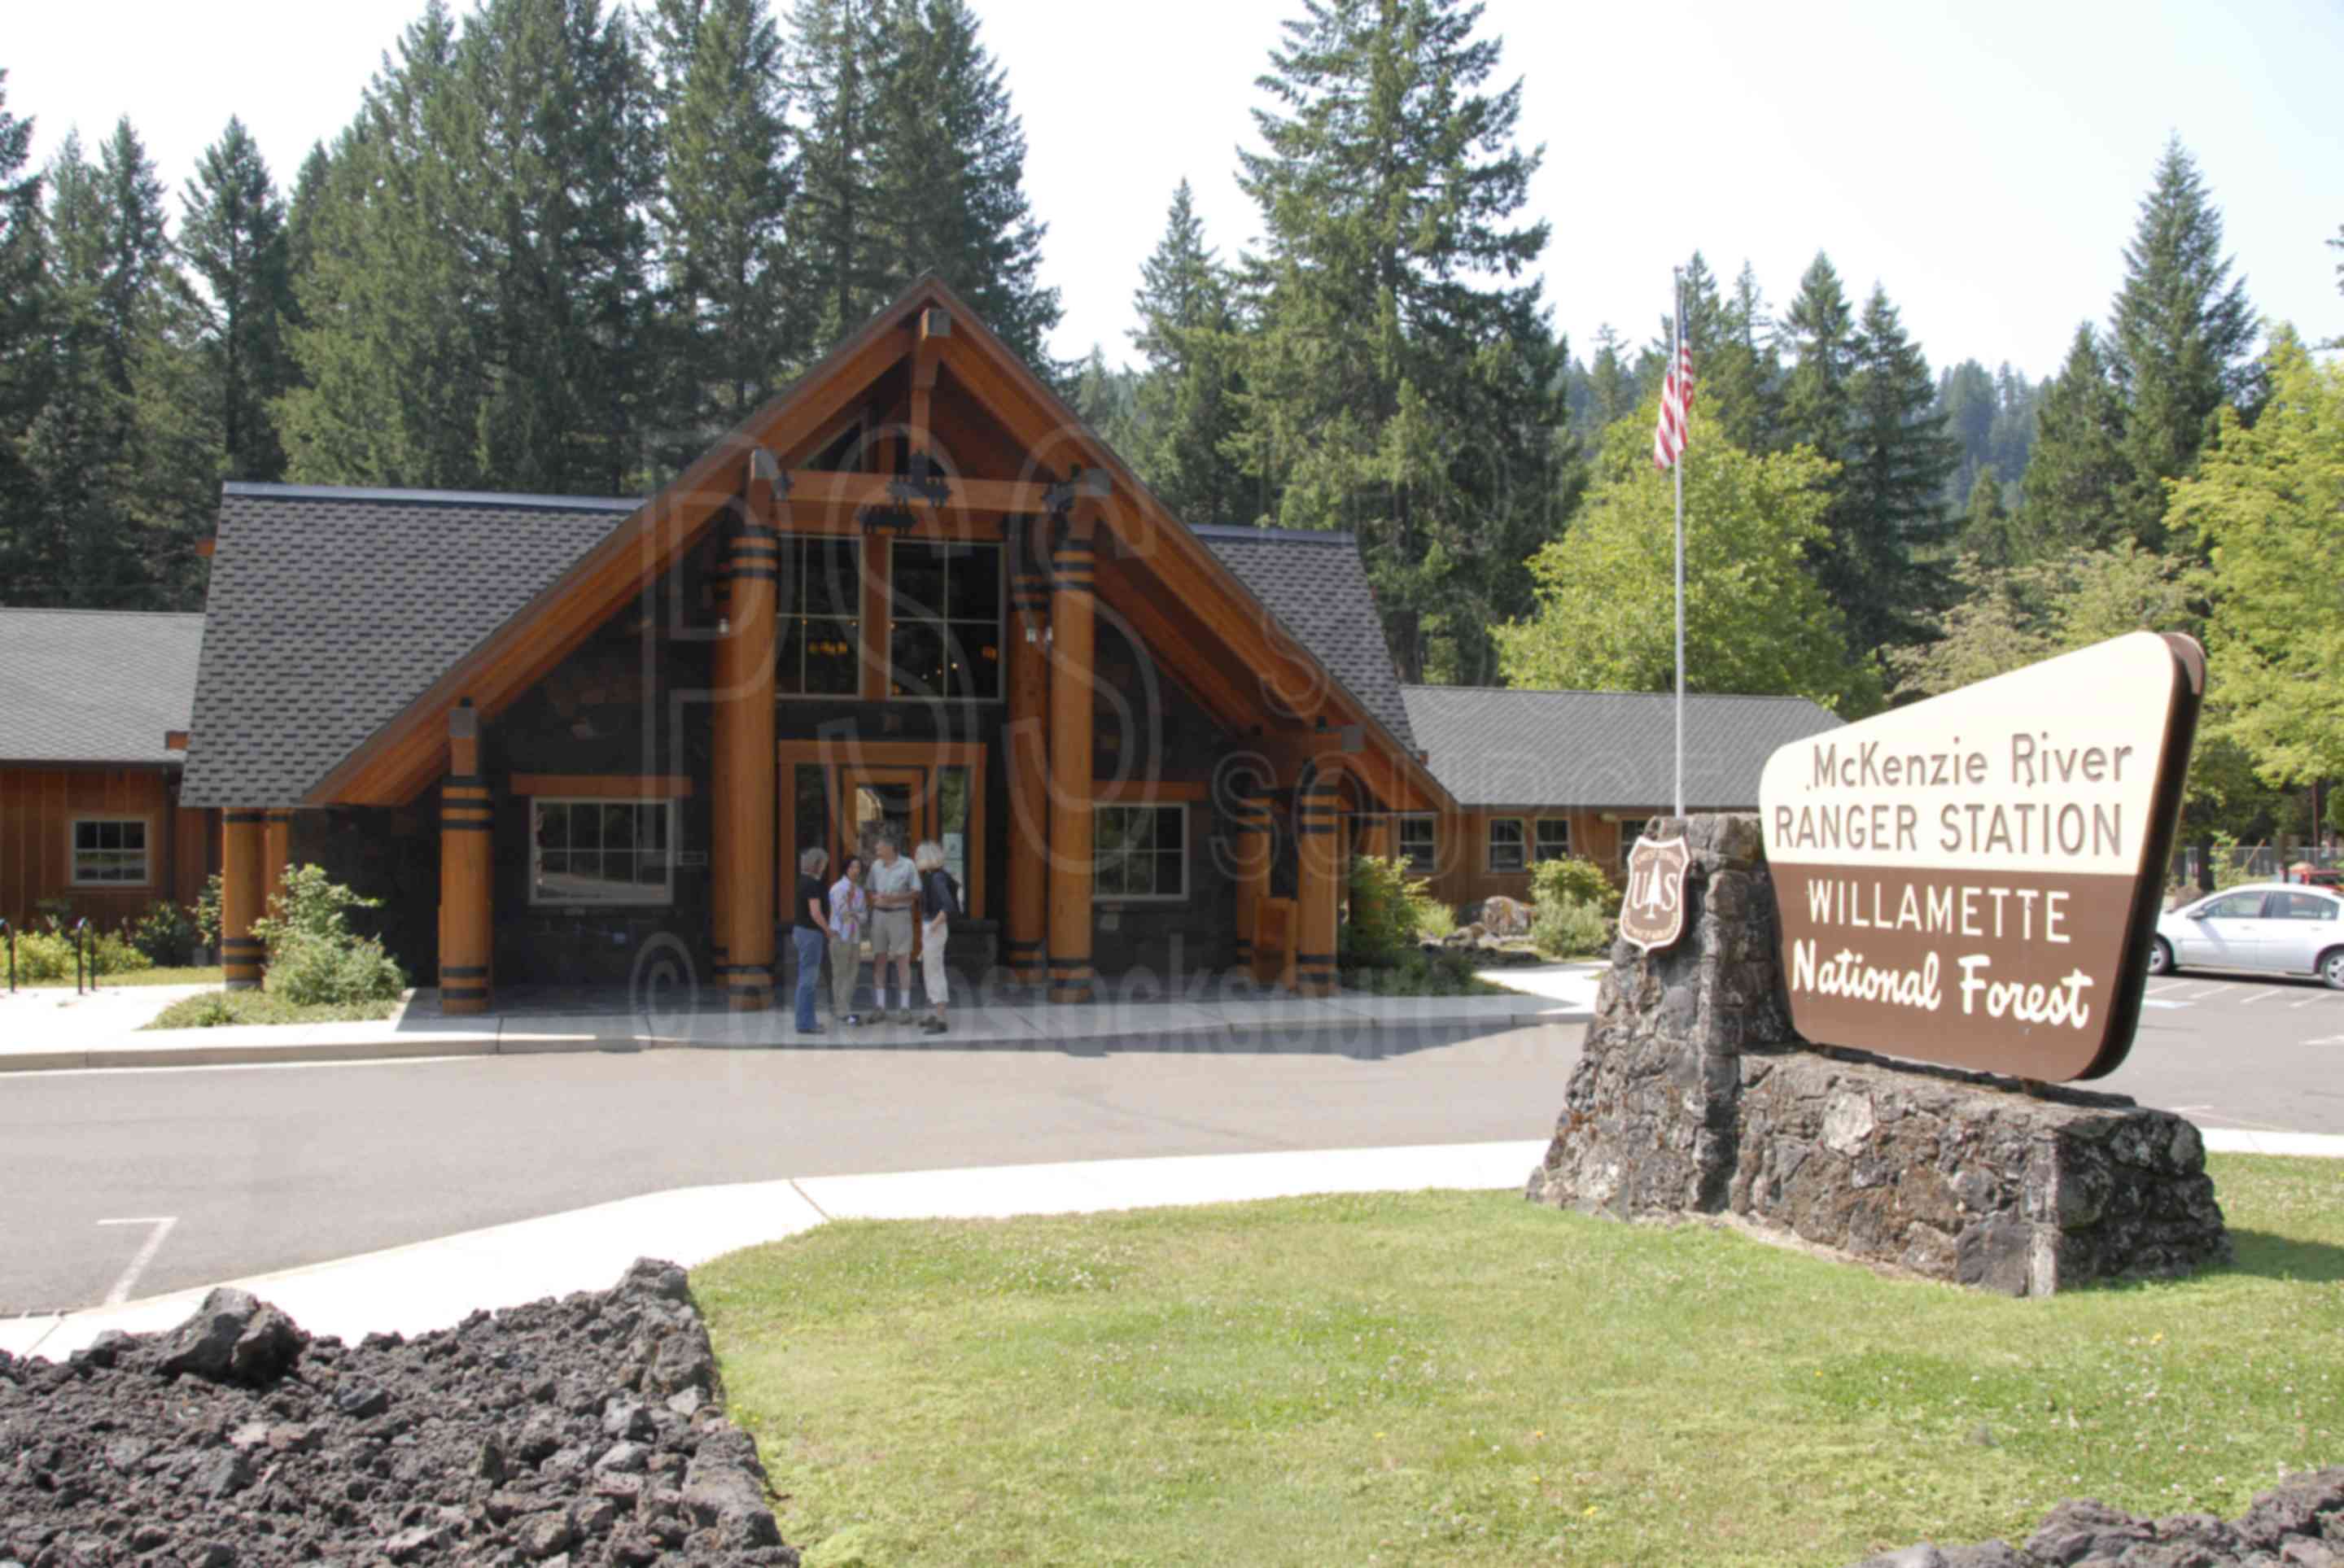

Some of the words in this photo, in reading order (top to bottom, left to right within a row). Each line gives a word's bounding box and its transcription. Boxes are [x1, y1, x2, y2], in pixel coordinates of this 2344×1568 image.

[1812, 735, 1988, 788] McKenzie
[2011, 732, 2133, 784] River
[1774, 803, 1918, 851] RANGER
[1939, 802, 2123, 857] STATION
[1807, 879, 2071, 944] WILLAMETTE
[1791, 938, 1941, 1011] National
[1957, 954, 2095, 1029] Forest
